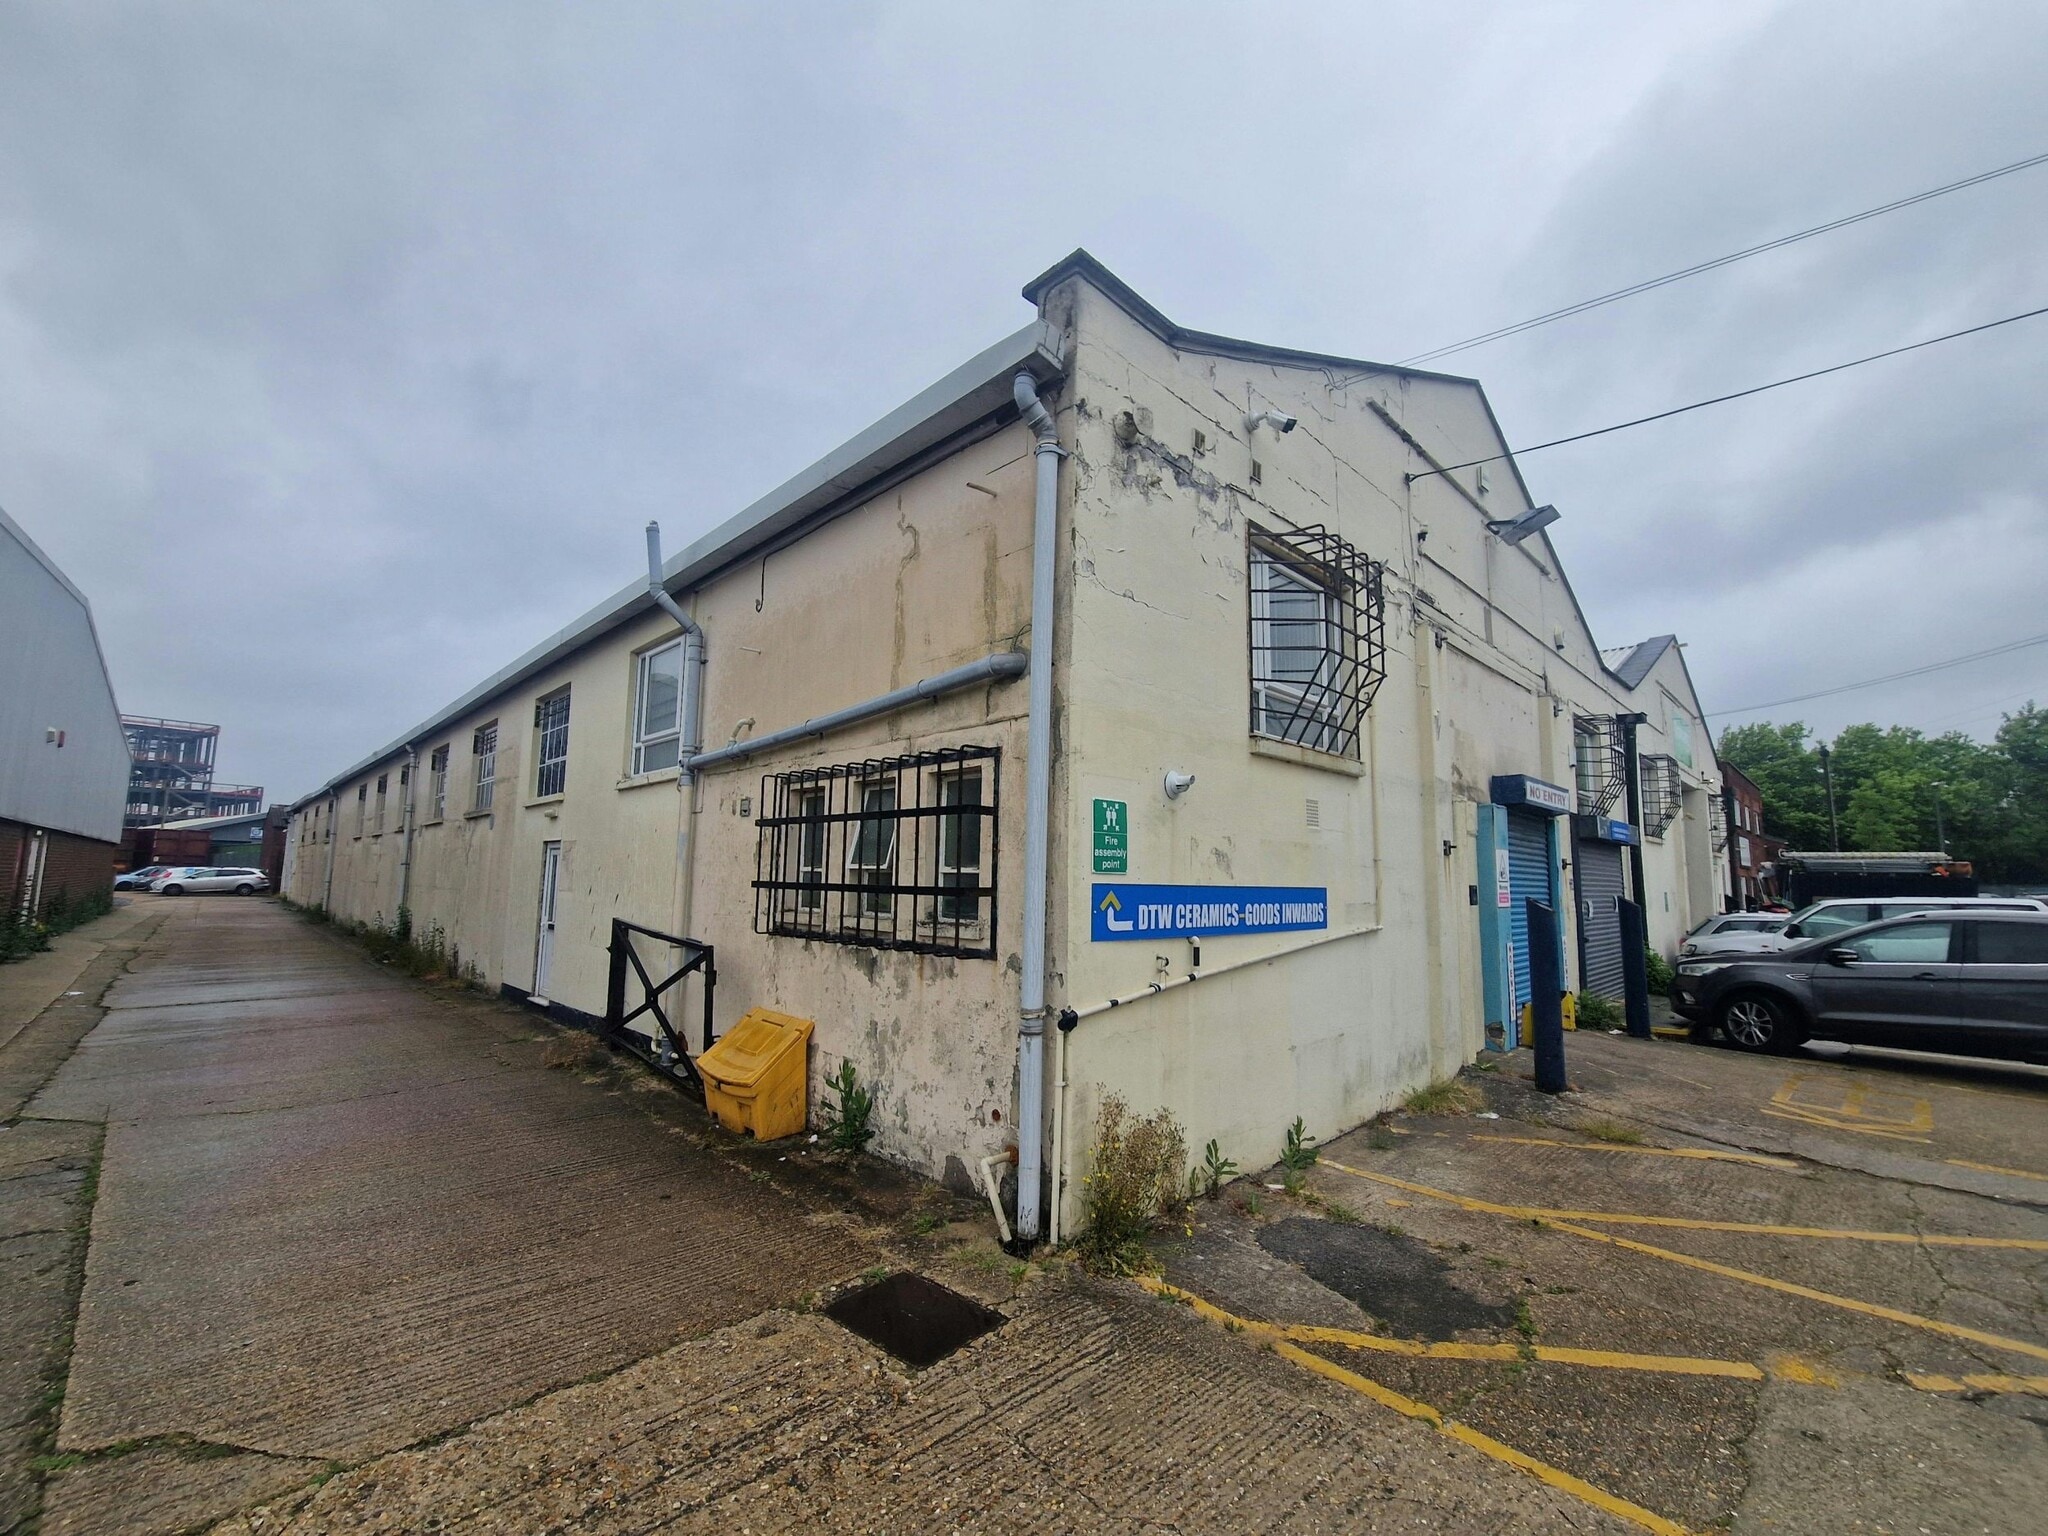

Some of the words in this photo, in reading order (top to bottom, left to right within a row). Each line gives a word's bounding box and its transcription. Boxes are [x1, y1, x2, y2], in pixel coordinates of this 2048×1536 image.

[1529, 785, 1541, 799] NO
[1542, 789, 1567, 807] ENTRY
[1104, 835, 1118, 846] Fire
[1094, 847, 1127, 860] assembly
[1102, 859, 1120, 871] point
[1138, 904, 1173, 930] DTW
[1282, 902, 1324, 924] INWARDS
